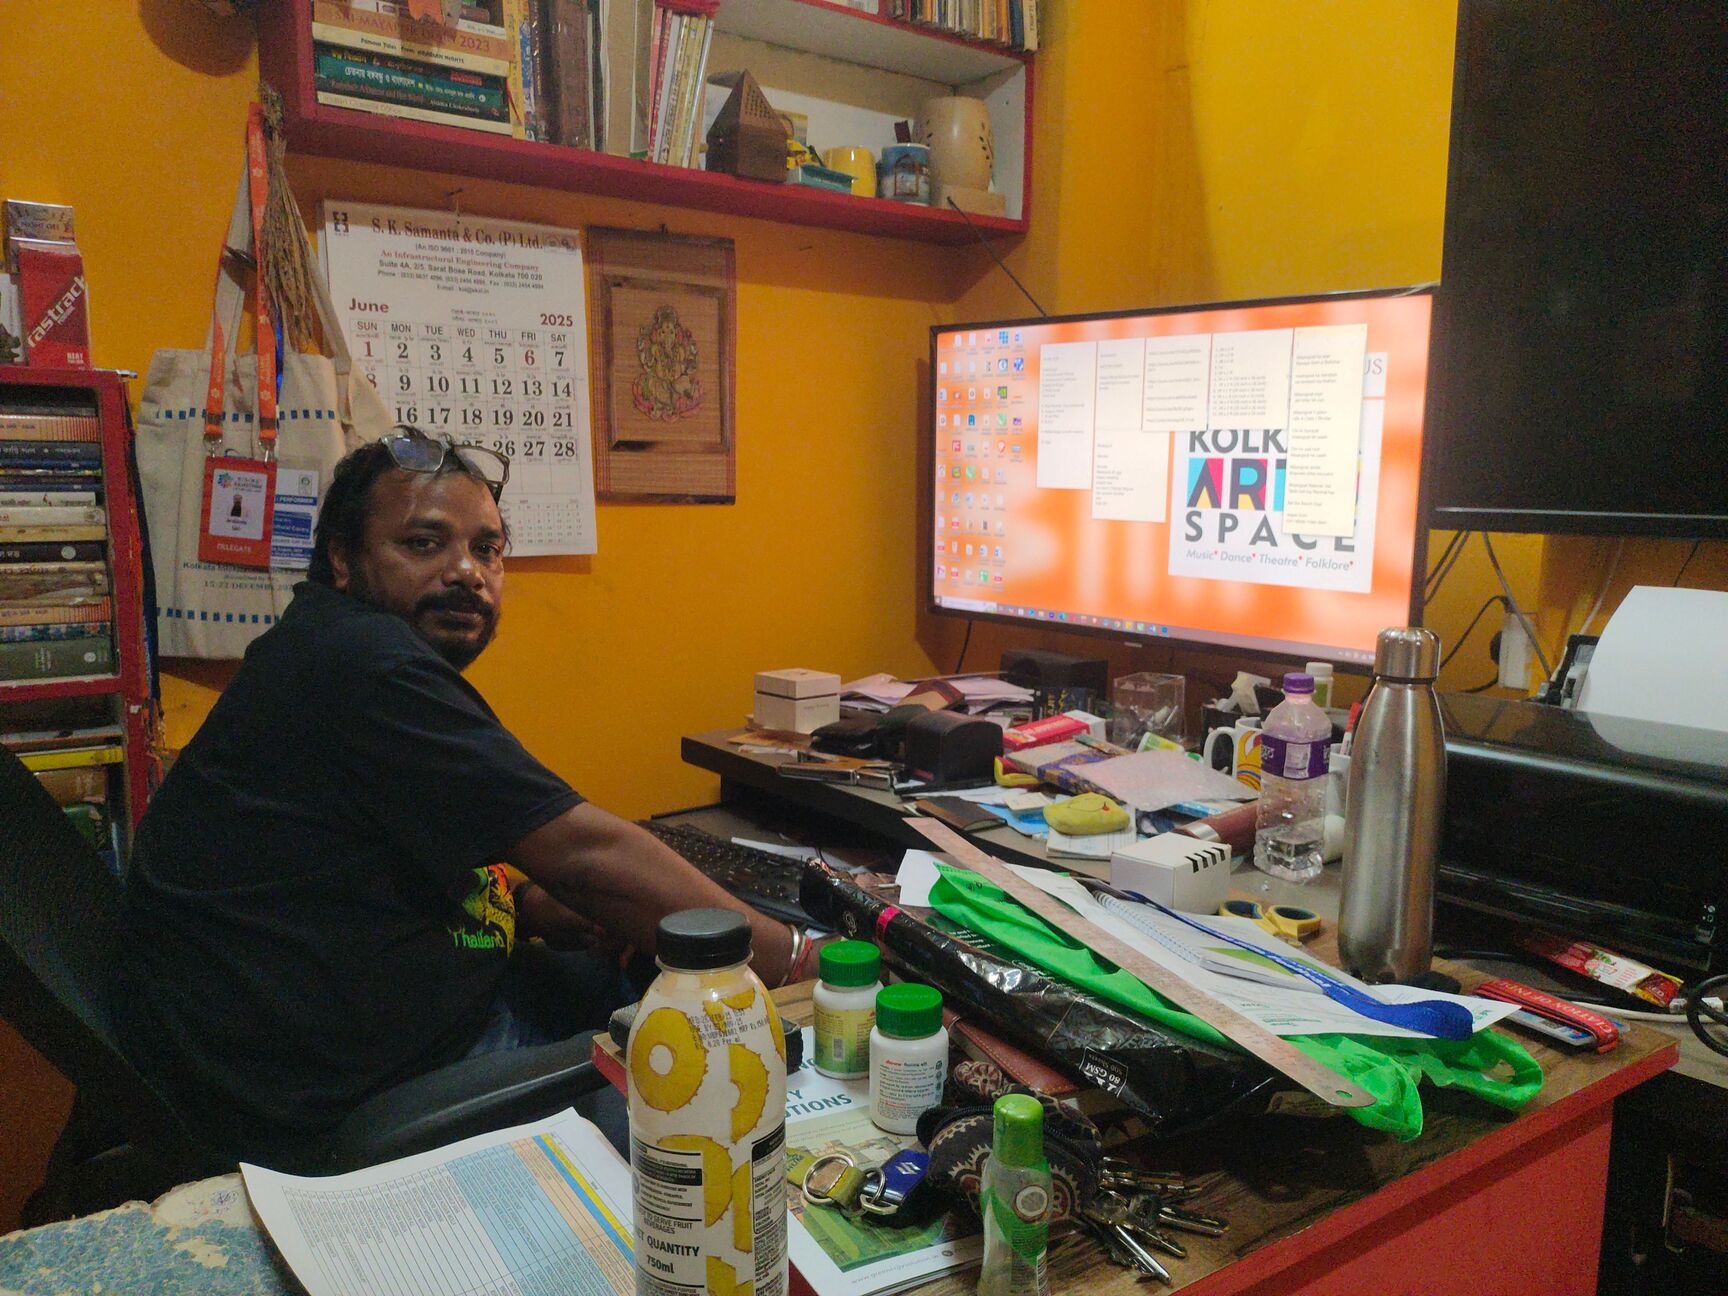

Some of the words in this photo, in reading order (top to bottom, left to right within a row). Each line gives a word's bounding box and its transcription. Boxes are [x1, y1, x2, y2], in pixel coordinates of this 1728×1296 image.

[360, 38, 381, 47] Famous
[460, 35, 490, 51] 2023
[371, 217, 384, 234] S.
[387, 218, 401, 235] K.
[404, 221, 459, 242] Samanta
[463, 226, 472, 243] &
[475, 229, 495, 245] Co.
[499, 231, 516, 246] (P)
[520, 232, 543, 249] Ltd.
[378, 259, 398, 268] Suite
[489, 271, 515, 279] Kolkata
[517, 272, 529, 280] 700
[530, 273, 543, 281] 020
[395, 251, 454, 263] Infrastructural
[456, 257, 502, 269] Engineering
[504, 262, 539, 272] Company
[349, 298, 389, 313] June
[540, 313, 573, 327] 2025
[357, 321, 378, 332] SUN
[391, 323, 411, 333] MON
[425, 325, 443, 335] TUE
[457, 328, 475, 338] WED
[489, 330, 507, 340] THU
[521, 332, 536, 341] FRI
[551, 334, 567, 343] SAT
[365, 341, 372, 357] 1
[397, 342, 409, 359] 2
[430, 344, 441, 361] 3
[462, 346, 473, 362] 4
[494, 348, 505, 364] 5
[525, 349, 535, 366] 6
[554, 351, 565, 367] 7
[400, 374, 411, 391] 9
[428, 376, 449, 393] 10
[460, 378, 480, 394] 11
[492, 379, 512, 395] 12
[522, 380, 543, 396] 13
[552, 381, 572, 398] 14
[396, 407, 418, 424] 16
[428, 408, 450, 425] 17
[462, 409, 483, 425] 18
[492, 410, 514, 426] 19
[523, 411, 544, 427] 20
[553, 411, 573, 427] 21
[493, 440, 515, 456] 26
[524, 441, 545, 456] 27
[554, 441, 575, 457] 28
[279, 496, 314, 504] PERFORMER
[217, 543, 252, 553] DELEGATE
[1186, 549, 1215, 560] Music
[1220, 551, 1253, 563] Dance
[1259, 554, 1299, 567] Theatre
[1305, 557, 1350, 571] Folklore
[1085, 1062, 1107, 1077] GSM
[1109, 1074, 1121, 1084] 80
[644, 1218, 675, 1234] BEVERAGES
[654, 1215, 672, 1227] SERVE
[673, 1221, 693, 1230] FRUIT
[647, 1235, 700, 1257] QUANTITY
[646, 1254, 675, 1274] 750ml
